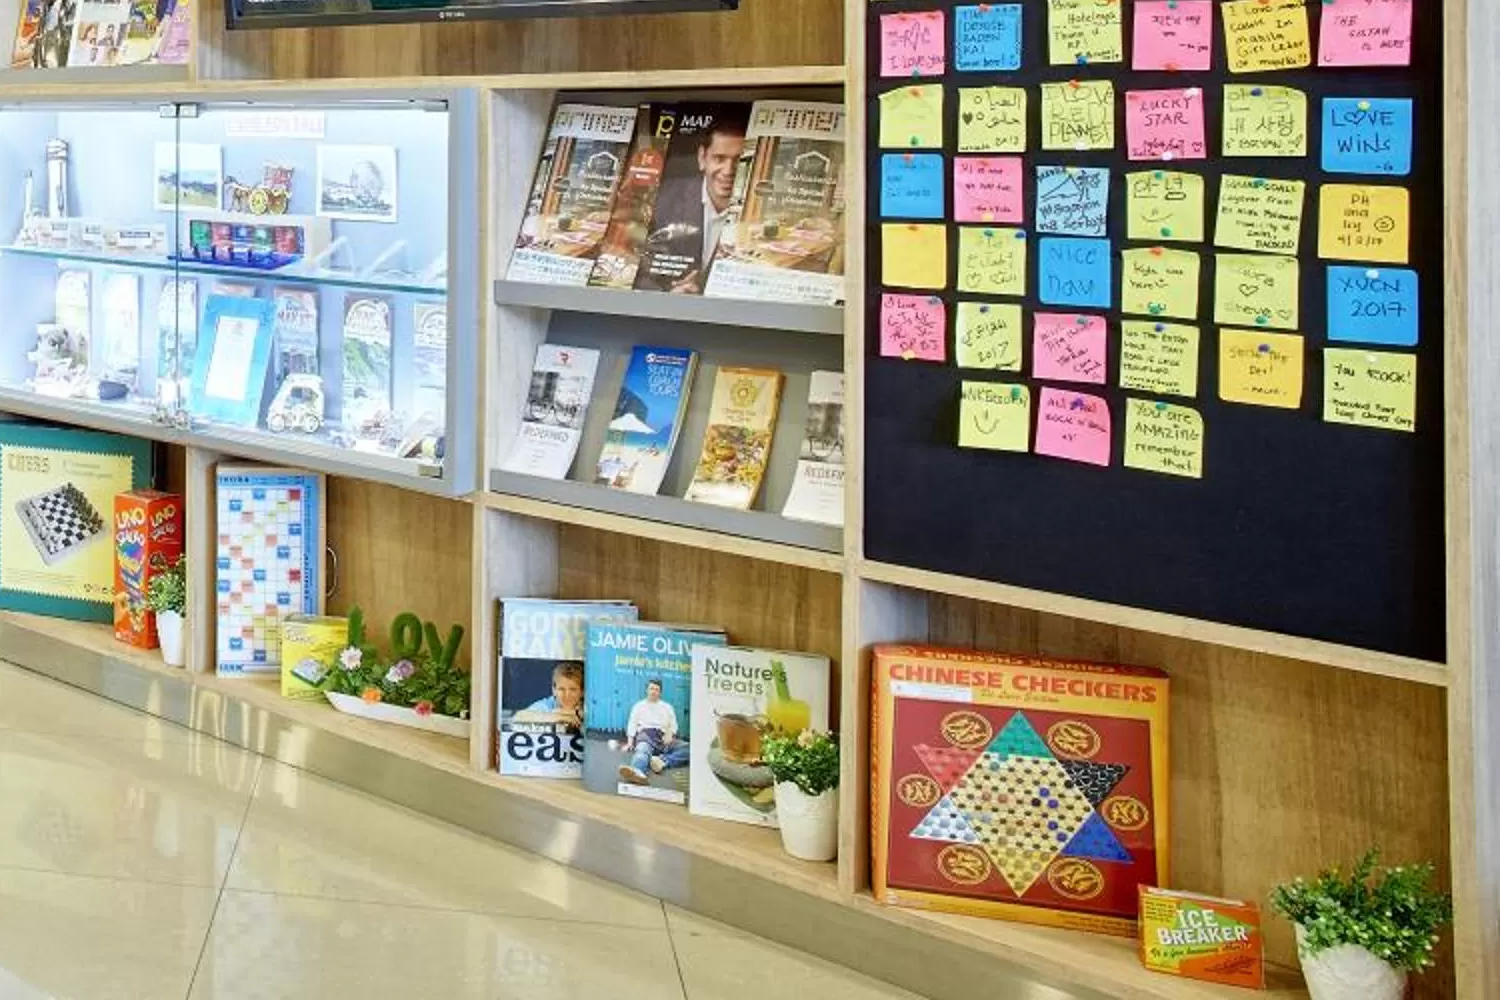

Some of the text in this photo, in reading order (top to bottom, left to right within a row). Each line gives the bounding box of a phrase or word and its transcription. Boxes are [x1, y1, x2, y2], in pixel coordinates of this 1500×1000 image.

[1139, 99, 1192, 113] LUCKY
[679, 115, 713, 128] MAP
[1144, 113, 1189, 127] STAR
[1350, 300, 1407, 317] 2017
[1135, 443, 1197, 458] remember
[116, 506, 146, 530] UNO
[150, 503, 177, 529] UNO
[590, 631, 646, 652] JAMIE
[705, 656, 788, 683] Nature's
[706, 674, 764, 697] Treats
[889, 663, 1004, 689] CHINESE
[1012, 673, 1158, 704] CHECKERS
[1176, 909, 1219, 929] ICE
[1156, 924, 1249, 946] BREAKER
